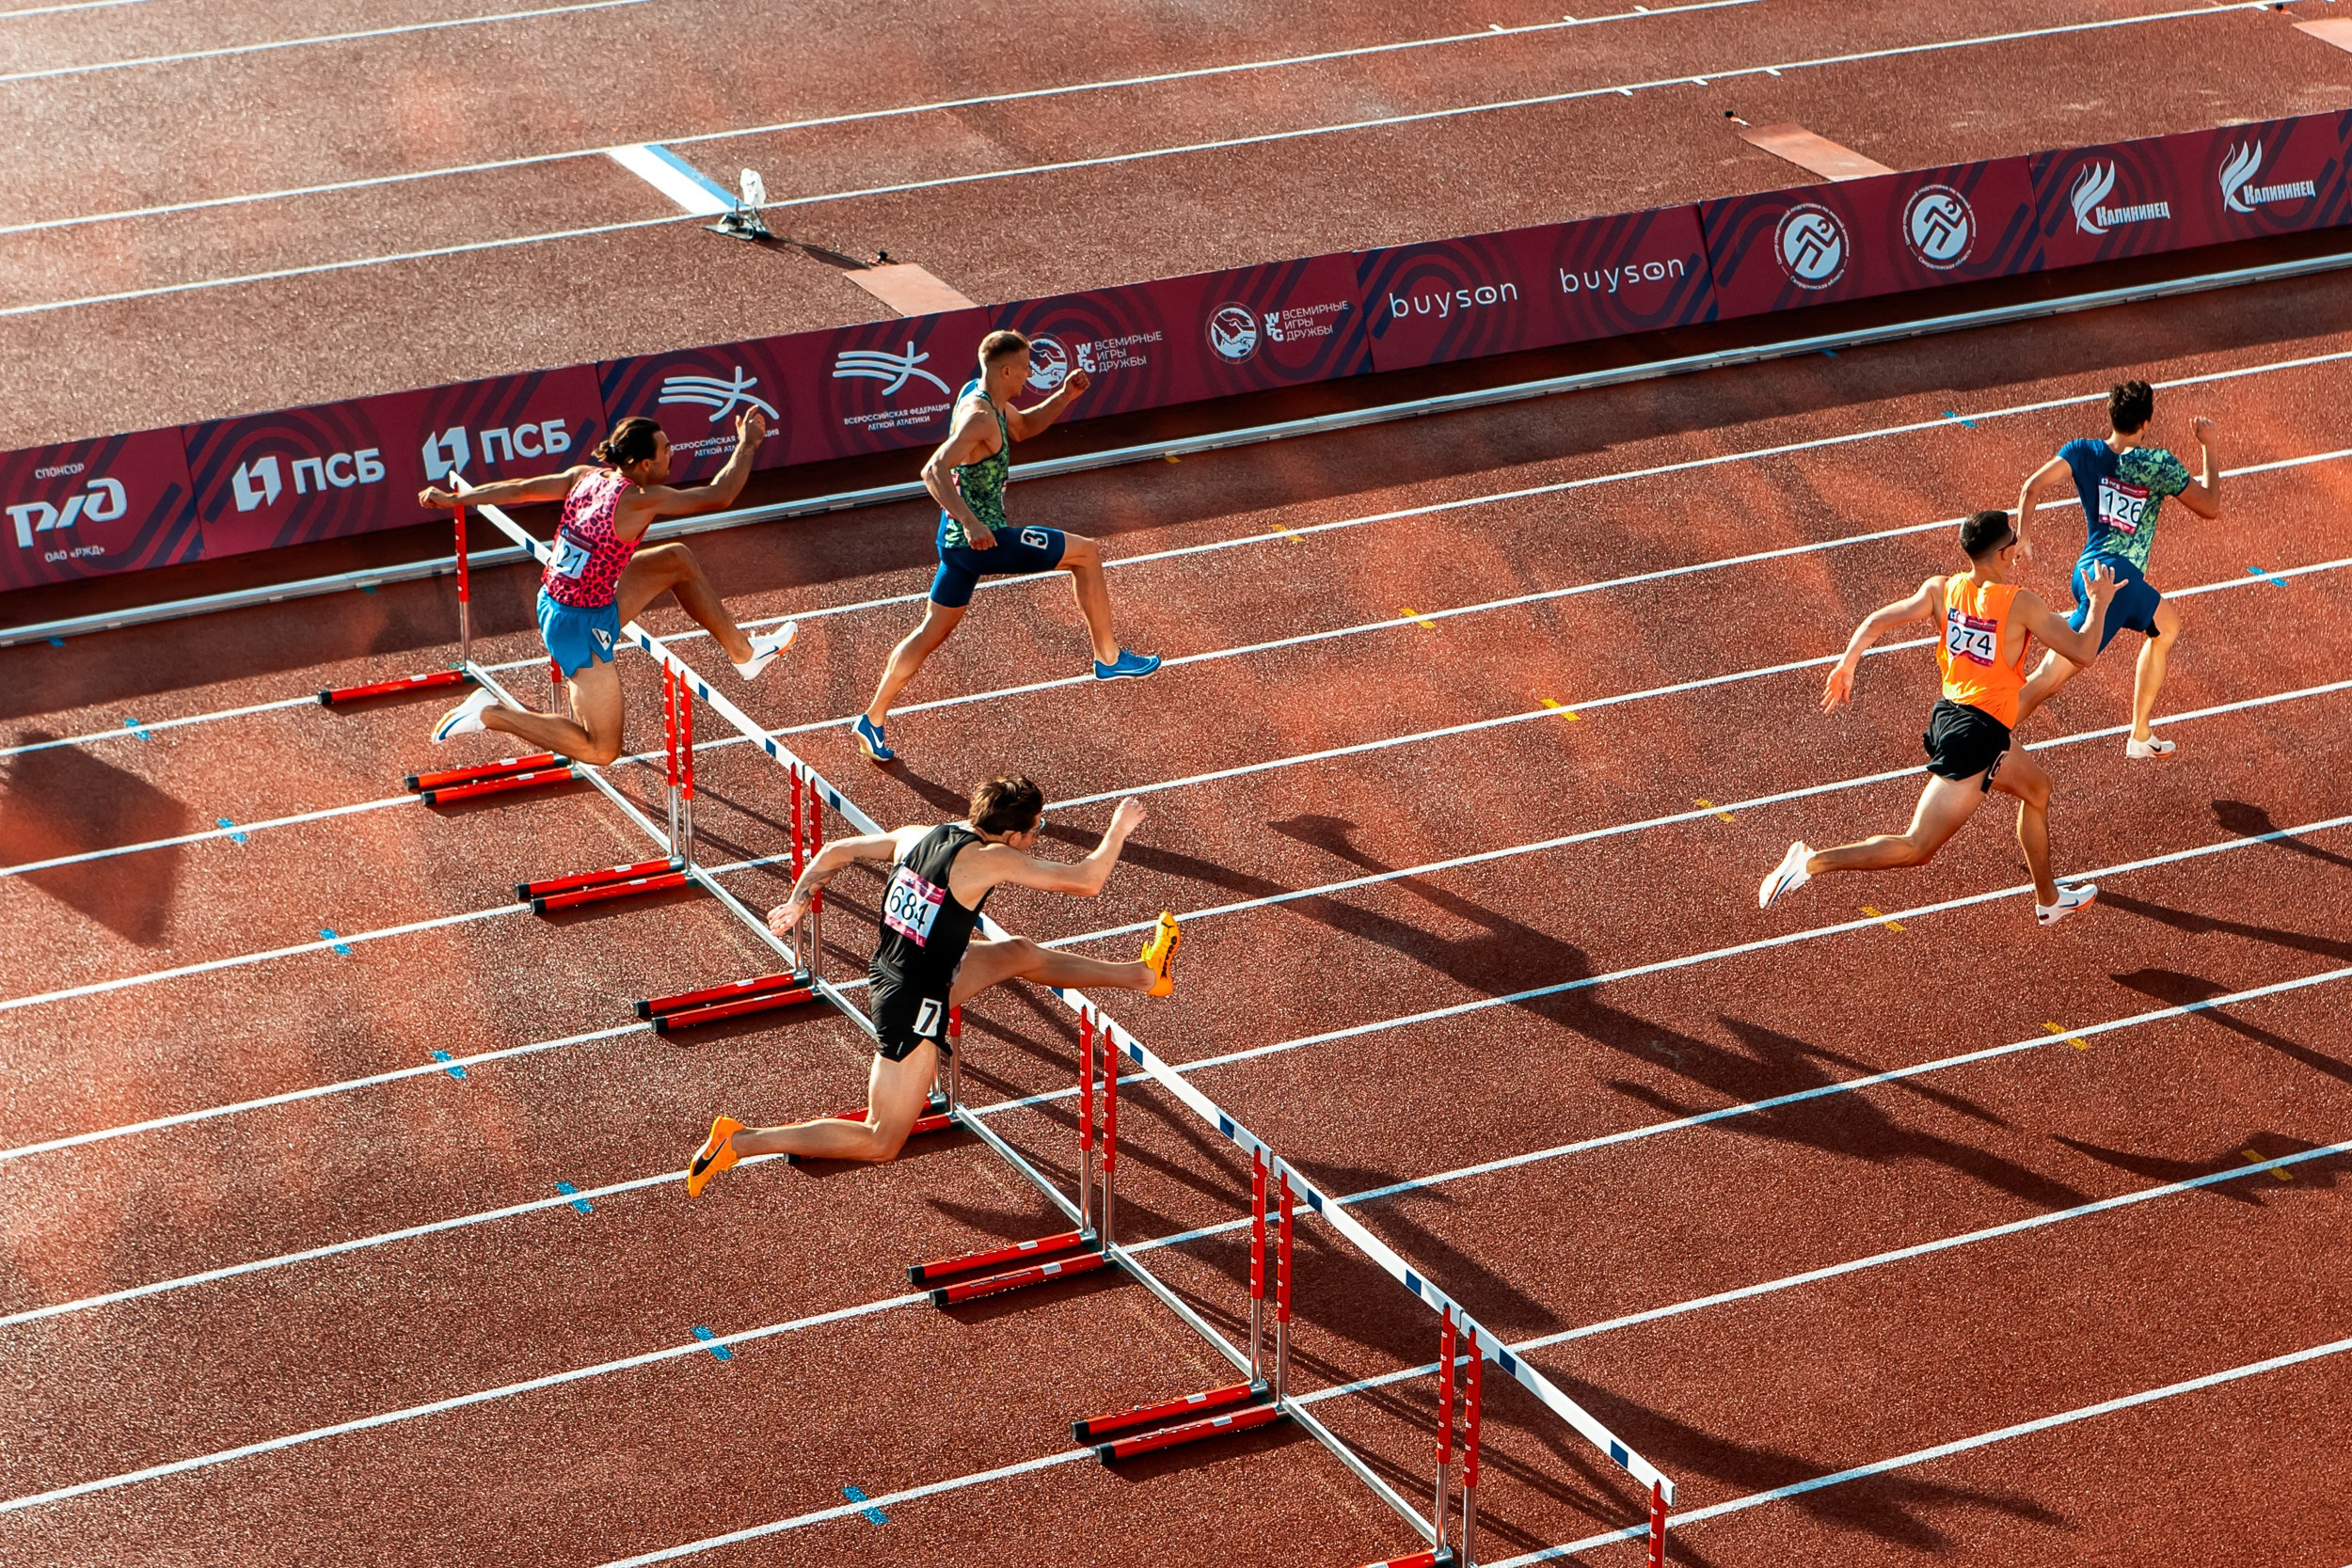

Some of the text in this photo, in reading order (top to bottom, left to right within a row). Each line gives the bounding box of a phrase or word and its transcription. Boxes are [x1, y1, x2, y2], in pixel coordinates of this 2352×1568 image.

[1559, 258, 1685, 293] buyson
[1282, 300, 1350, 320] ВСЕМИРНЫЕ
[1389, 281, 1518, 319] buyson
[1284, 317, 1314, 330] ИГРЫ
[1286, 325, 1334, 342] ДРУЖБЫ
[1094, 331, 1163, 351] ВСЕМИРНЫЕ
[1096, 348, 1127, 361] ИГРЫ
[1099, 356, 1147, 373] ДРУЖБЫ
[844, 403, 951, 425] ВСЕРОССИЙСКАЯ ФЕДЕРАЦИЯ
[867, 416, 930, 431] ЛЕГКОЙ АТЛЕТИКИ
[480, 419, 571, 464] ПСБ
[670, 436, 737, 452] ВСЕРОССИЙСКАЯ
[694, 446, 723, 457] ЛЕГКОЙ
[35, 463, 85, 480] СПОНСОР
[292, 448, 386, 494] ПСБ
[2105, 490, 2143, 525] 126
[1023, 531, 1048, 547] 3
[44, 549, 68, 562] ОАО
[1950, 626, 1992, 656] 274
[890, 885, 929, 930] 684
[919, 1002, 938, 1034] 7
